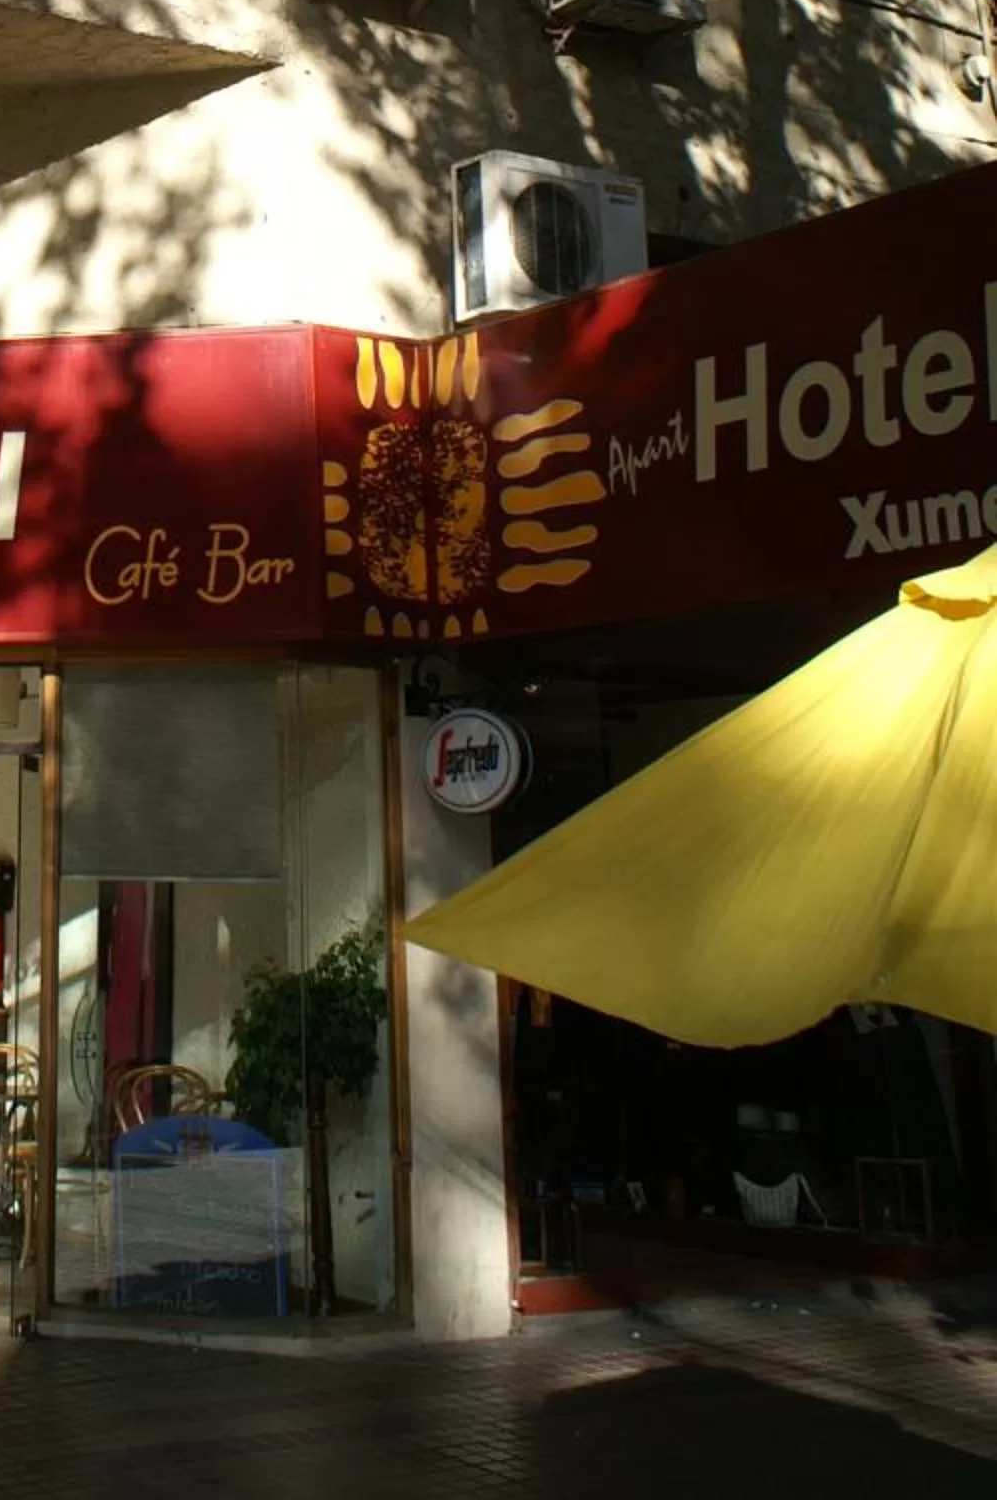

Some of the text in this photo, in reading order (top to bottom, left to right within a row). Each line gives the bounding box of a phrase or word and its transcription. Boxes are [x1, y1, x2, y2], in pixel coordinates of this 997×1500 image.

[607, 409, 690, 497] Apart
[84, 522, 296, 606] Café Bar
